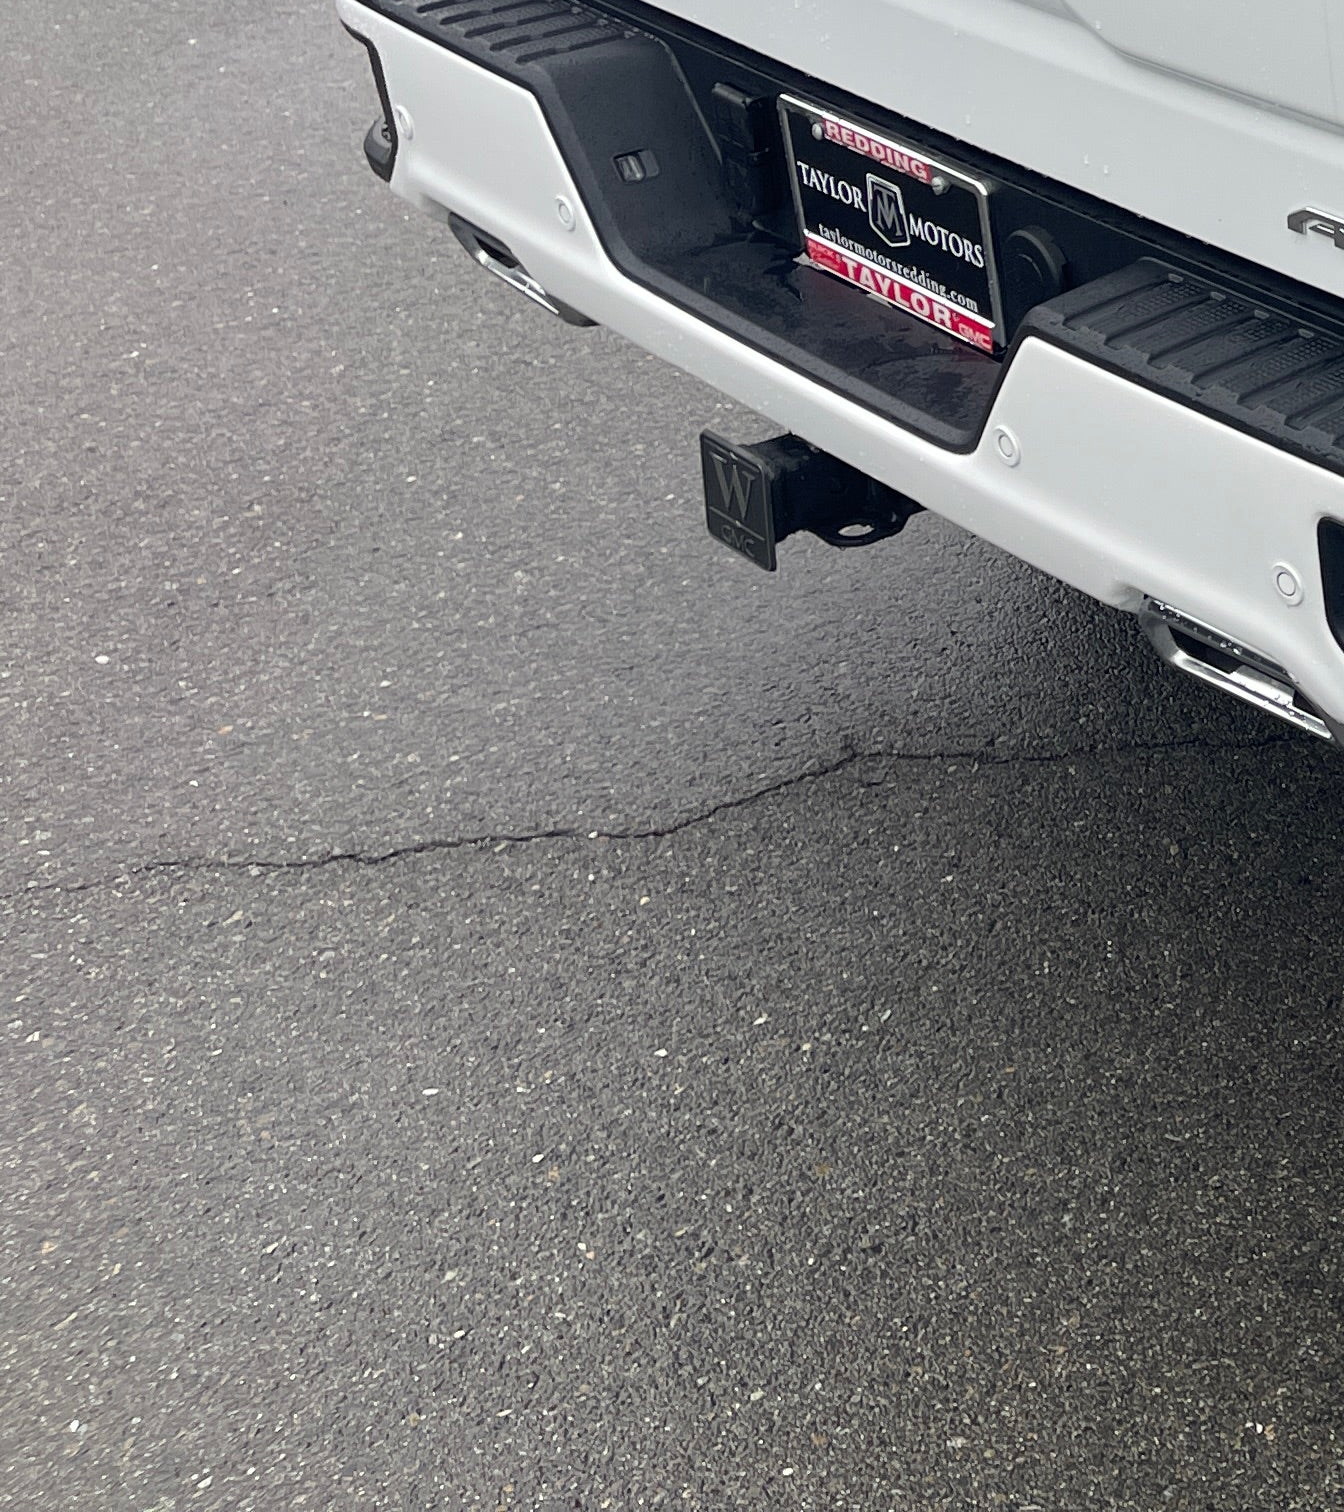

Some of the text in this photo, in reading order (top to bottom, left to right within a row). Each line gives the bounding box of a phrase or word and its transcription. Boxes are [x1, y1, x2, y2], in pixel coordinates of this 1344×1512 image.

[823, 119, 929, 180] REDDING
[797, 160, 867, 213] TAYLOR
[908, 212, 985, 269] MOTORS
[818, 221, 979, 314] taylormotorsredding.com
[841, 255, 992, 349] TAYLOR GMC
[709, 450, 756, 522] W
[720, 524, 756, 559] GMC
